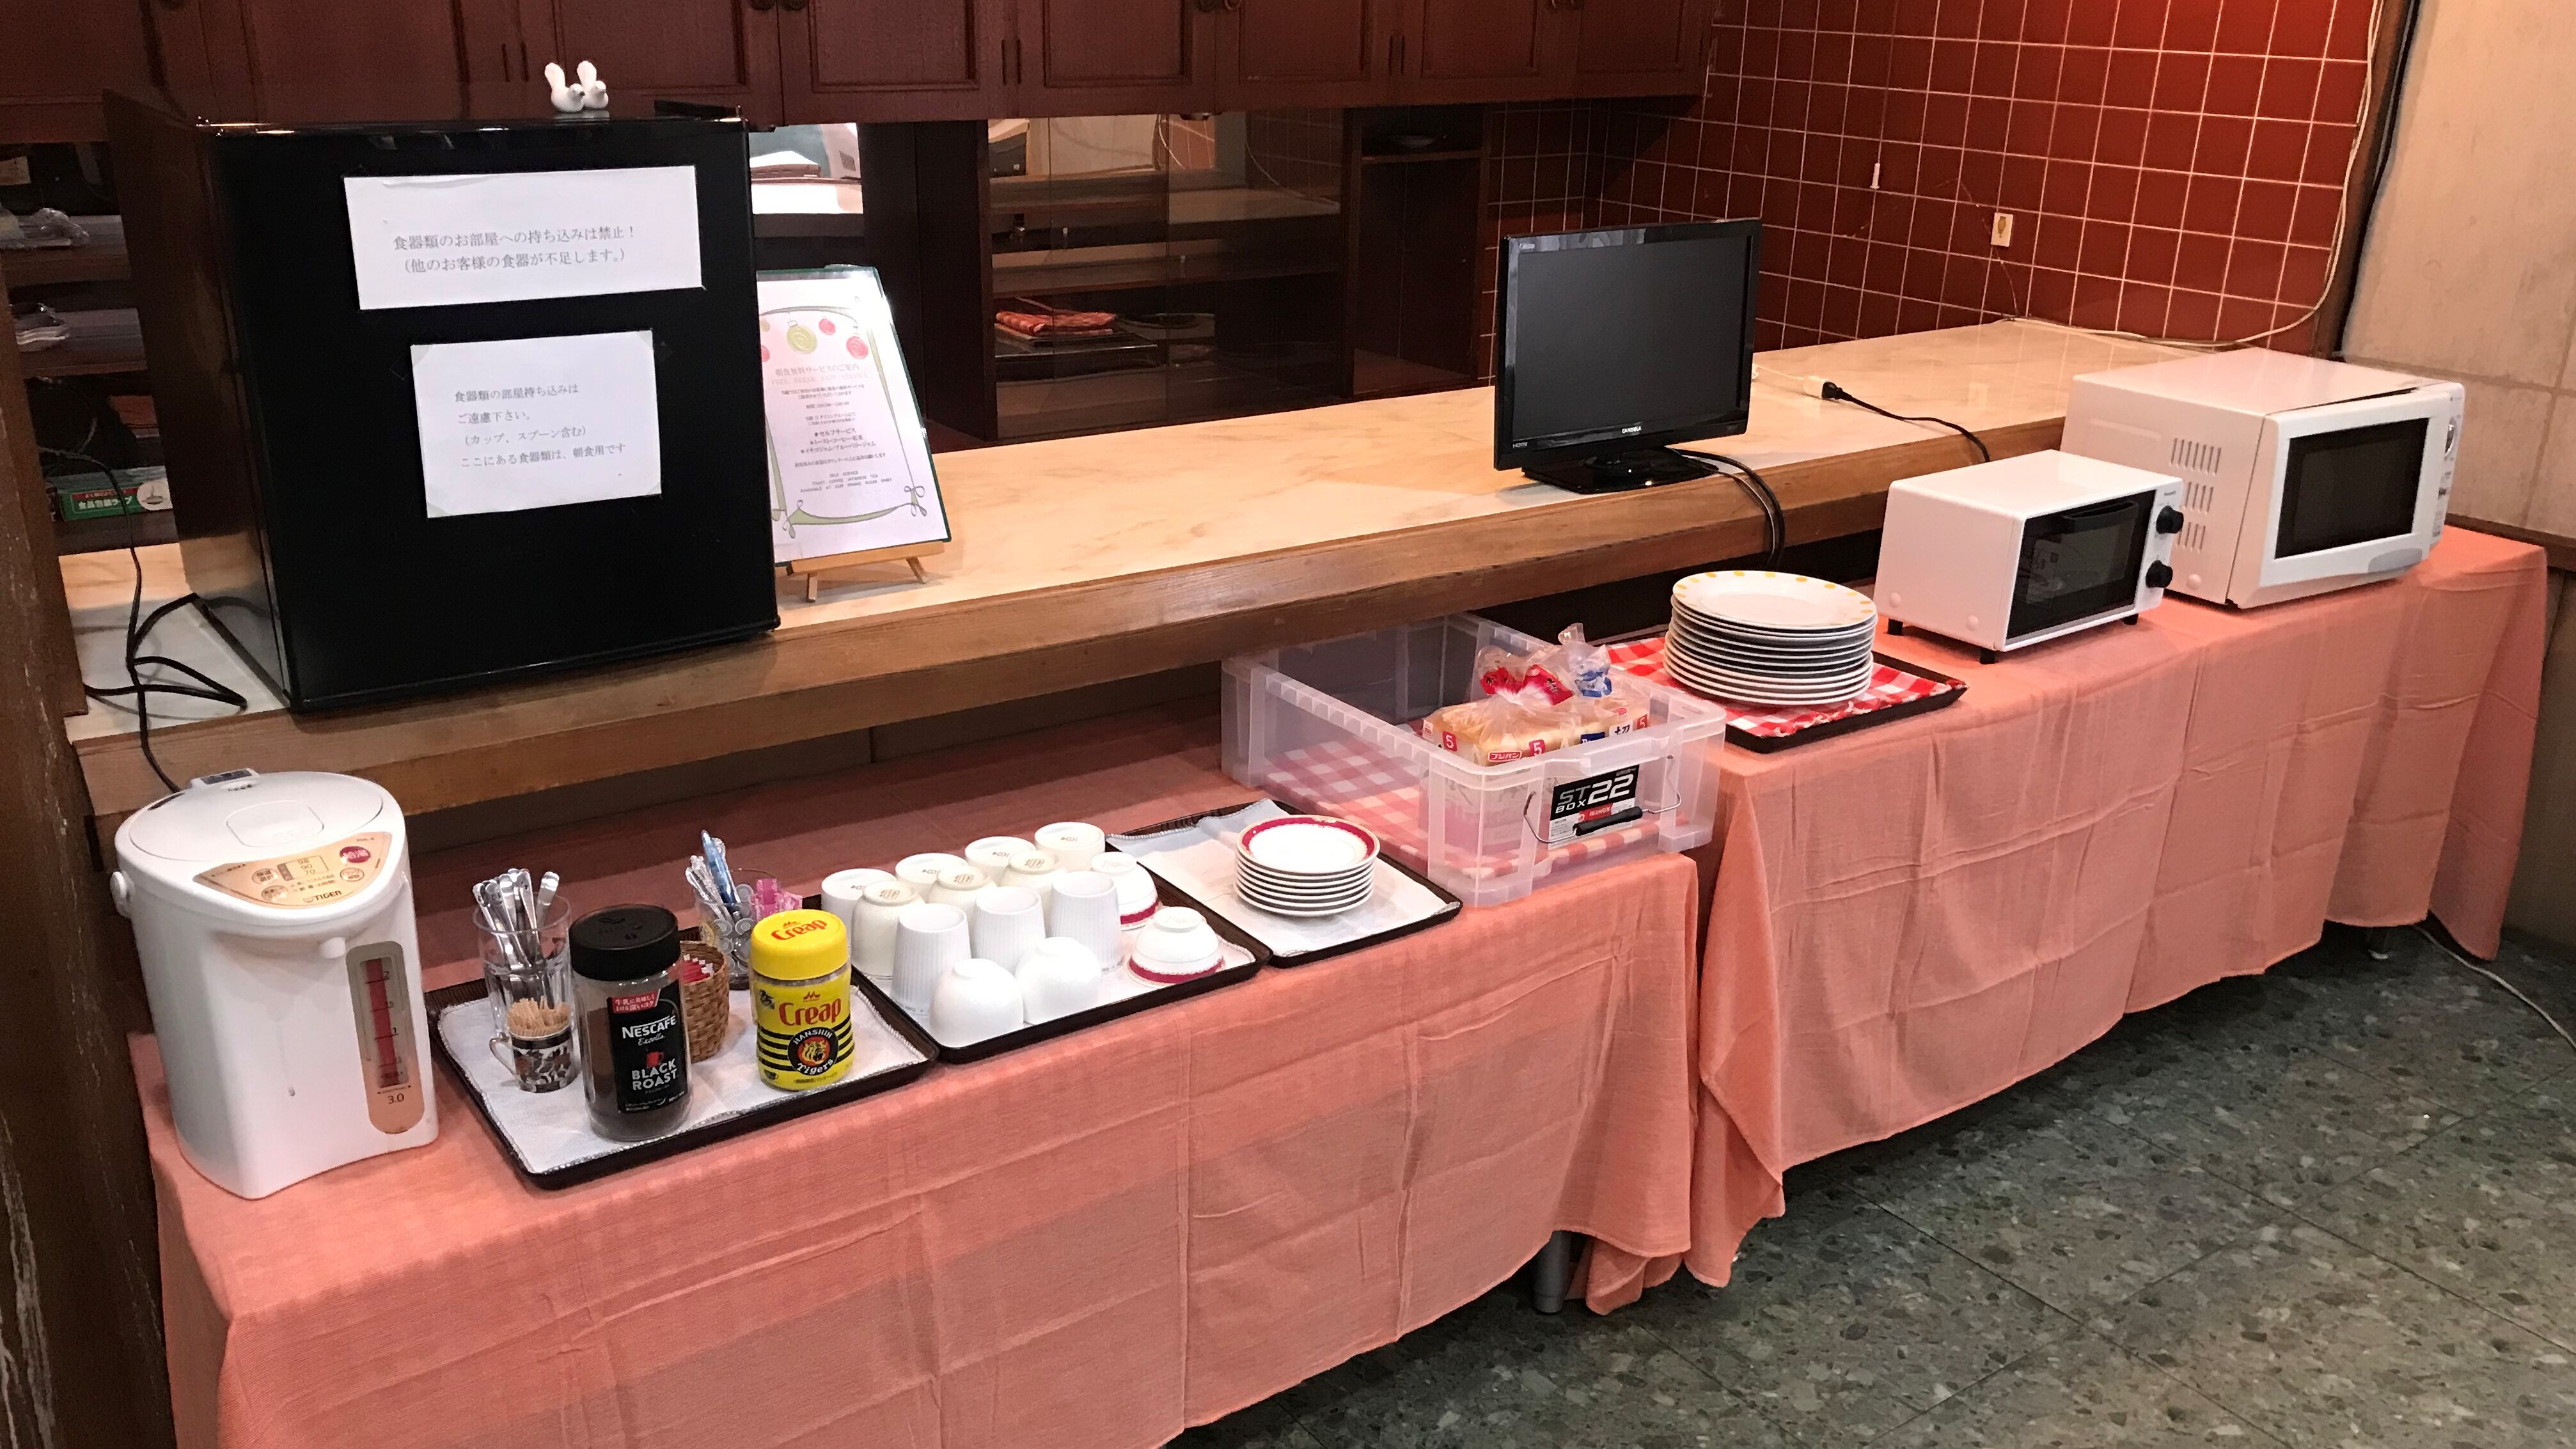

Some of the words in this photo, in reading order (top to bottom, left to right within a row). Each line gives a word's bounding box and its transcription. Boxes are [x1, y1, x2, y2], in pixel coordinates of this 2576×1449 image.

[455, 384, 579, 402] 食器類の部屋持ち込みは
[457, 410, 531, 425] ご遠慮下さい。
[461, 443, 626, 467] ここにある食器類は、朝食用です
[1445, 735, 1455, 749] 5
[1533, 742, 1543, 756] 5
[1557, 785, 1591, 806] ST
[1587, 773, 1634, 805] 22
[1555, 799, 1587, 814] BOX
[313, 890, 343, 901] TIGER
[771, 920, 828, 941] Creap
[384, 971, 389, 979] 2
[778, 998, 842, 1026] Creap
[792, 1028, 833, 1046] HANSHIN
[632, 1058, 677, 1081] BLACK
[796, 1058, 833, 1076] Tigers
[632, 1068, 678, 1091] ROAST
[388, 1093, 405, 1105] 3.0
